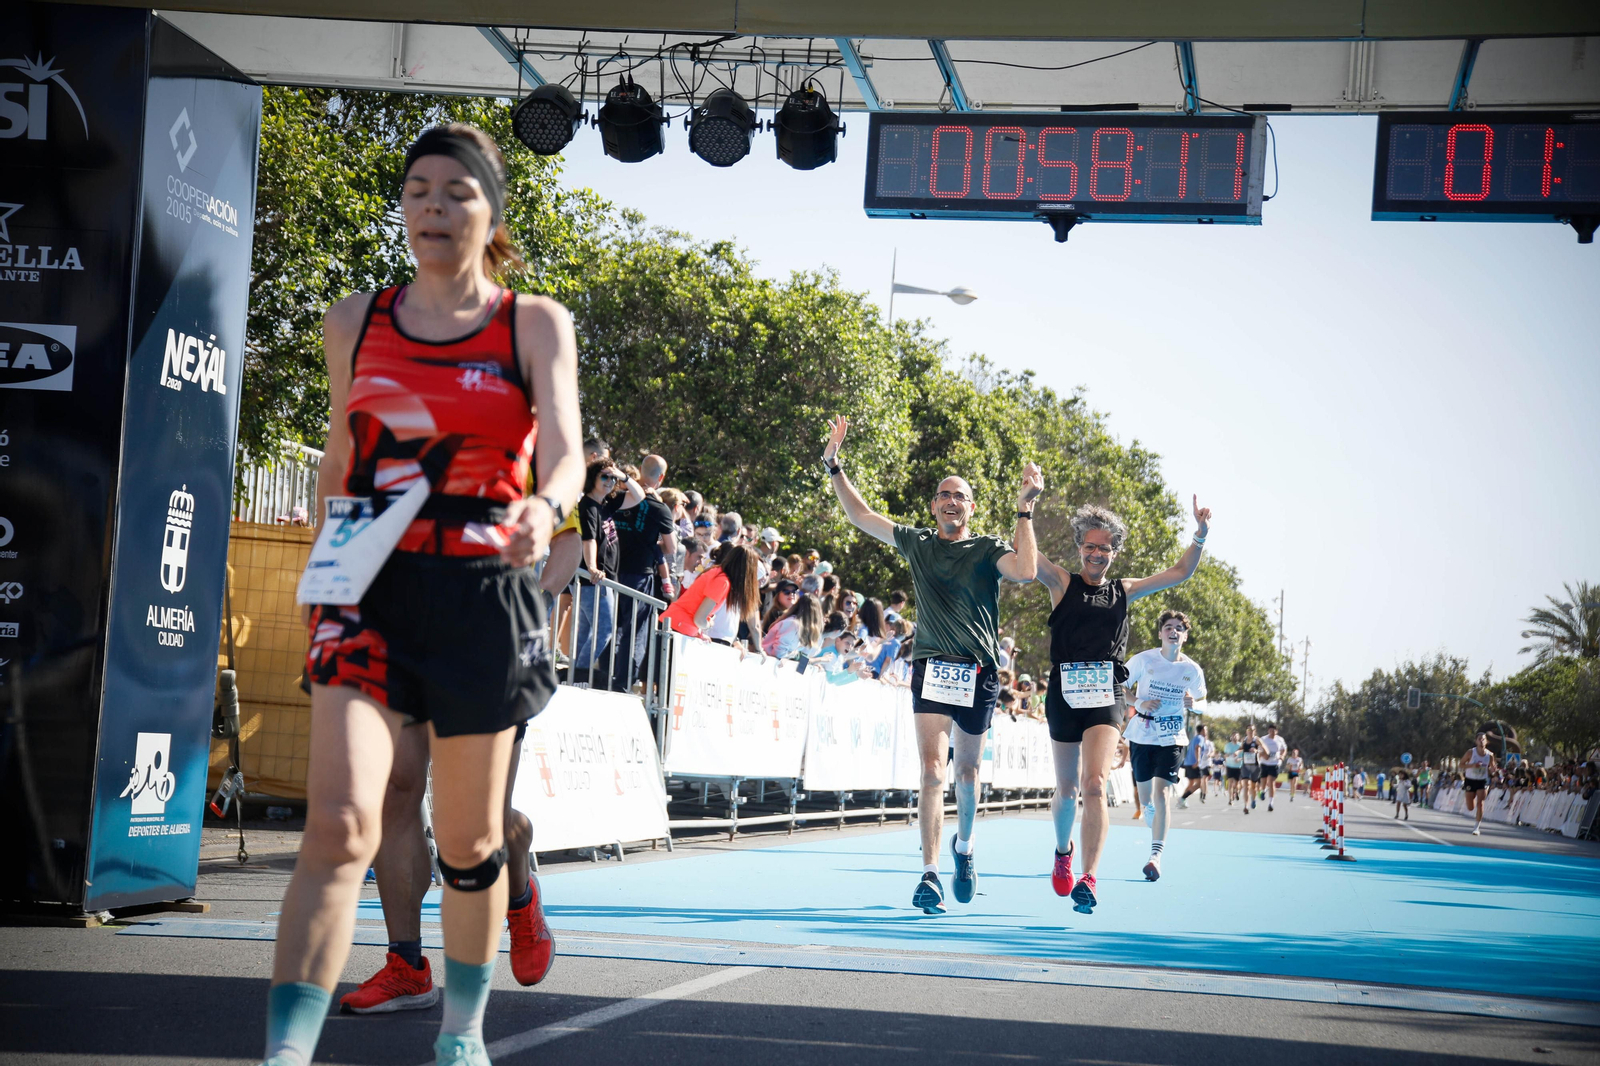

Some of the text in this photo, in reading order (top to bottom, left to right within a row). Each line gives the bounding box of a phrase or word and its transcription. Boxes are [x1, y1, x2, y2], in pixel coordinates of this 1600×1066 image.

[166, 174, 238, 227] COOPERACIÓN
[166, 196, 192, 224] 2005
[0, 269, 40, 282] NTE
[166, 376, 182, 392] 2020
[146, 604, 195, 633] ALMERÍA
[158, 631, 184, 648] CIUDAD
[931, 665, 971, 683] 5536
[1066, 670, 1109, 685] 5535
[128, 825, 160, 837] DEPORTES
[160, 824, 169, 836] DE
